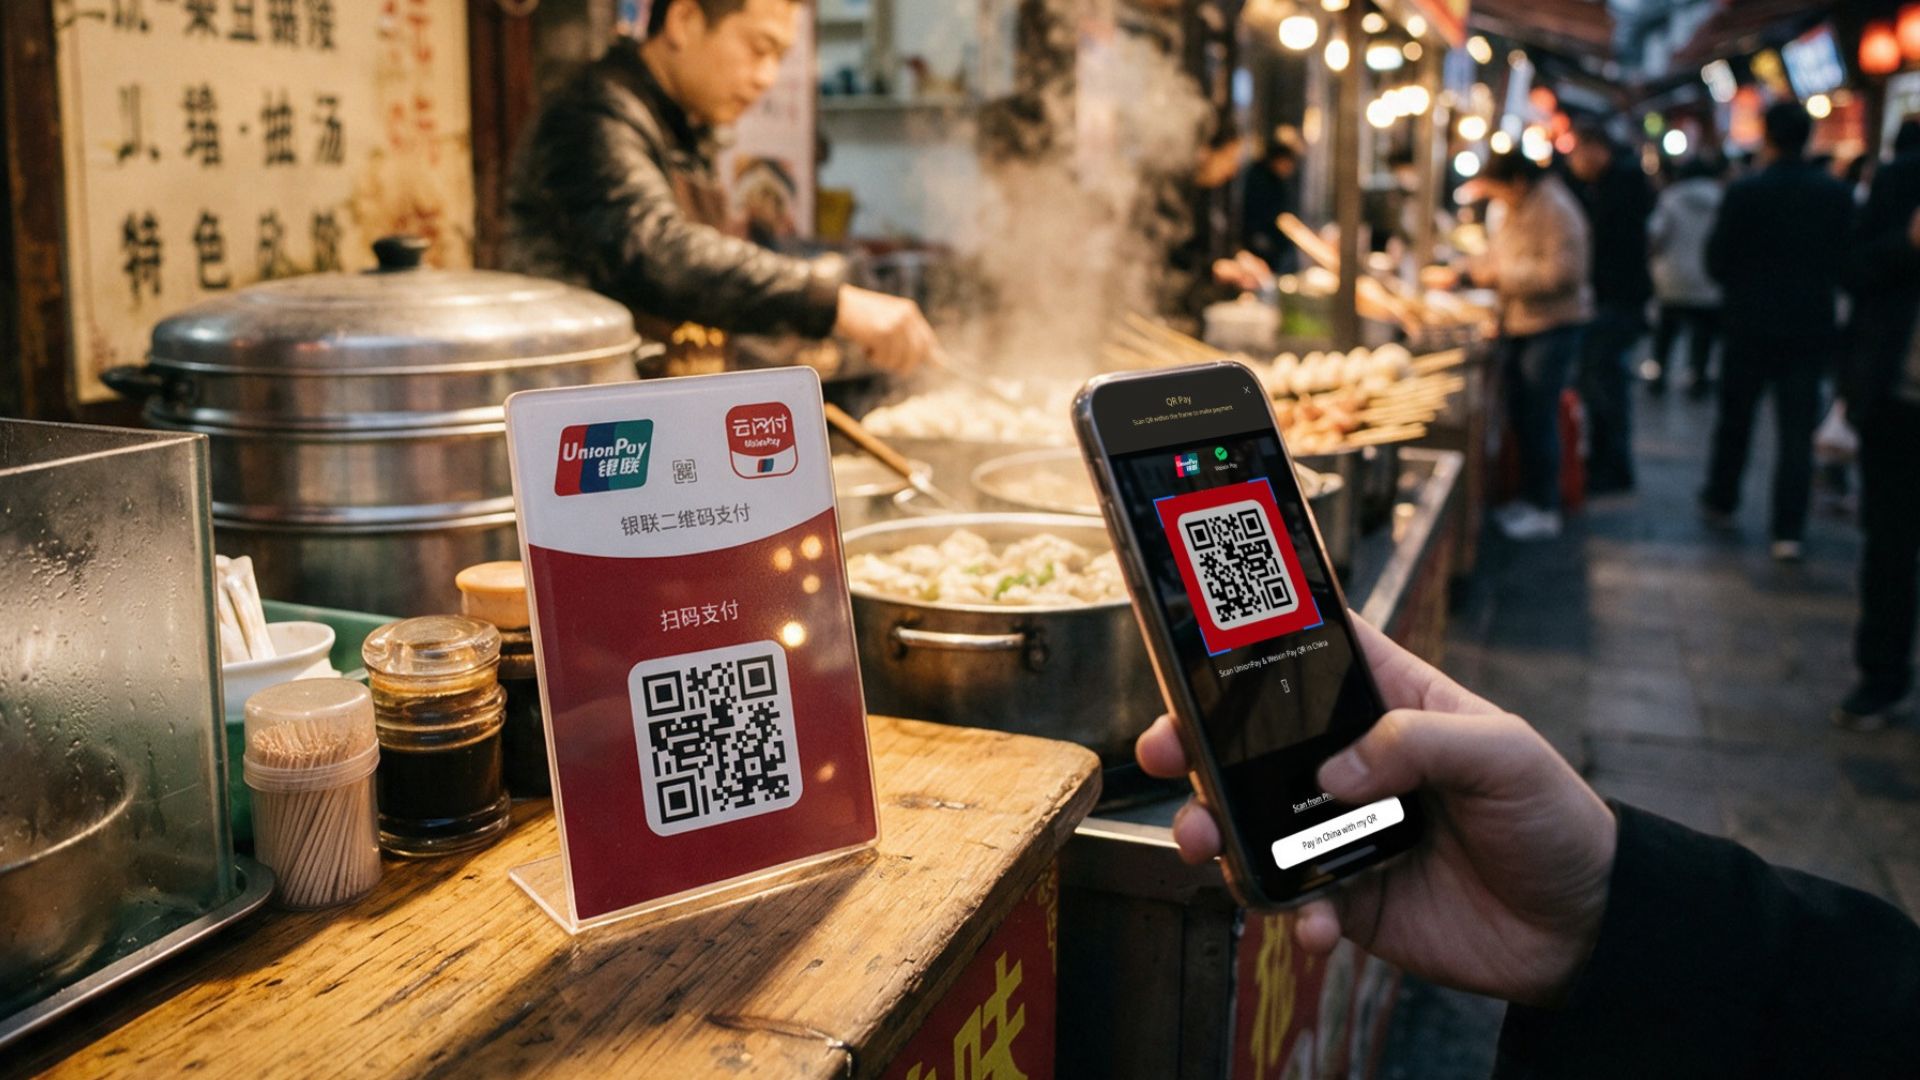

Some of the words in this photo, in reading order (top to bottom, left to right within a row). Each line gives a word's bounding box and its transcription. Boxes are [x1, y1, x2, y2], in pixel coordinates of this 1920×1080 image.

[1165, 397, 1178, 407] QR
[1179, 396, 1192, 406] Pay
[1132, 418, 1145, 426] Scan
[562, 437, 648, 462] UnionPay
[598, 457, 640, 478] 银联
[620, 502, 750, 537] 银联二维码支付
[660, 599, 740, 632] 扫码支付
[1219, 668, 1234, 678] Scan
[1234, 660, 1261, 673] UnionPay
[1261, 657, 1267, 665] &
[1286, 649, 1297, 658] Pay
[1297, 645, 1306, 655] QR
[1306, 643, 1312, 651] in
[1312, 640, 1329, 650] China
[1292, 802, 1307, 813] Scan
[1307, 798, 1322, 807] from
[1302, 840, 1315, 850] Pay
[1316, 836, 1322, 844] in
[1322, 829, 1342, 842] China
[1341, 822, 1357, 834] with
[1356, 819, 1367, 829] my
[1366, 813, 1378, 825] QR
